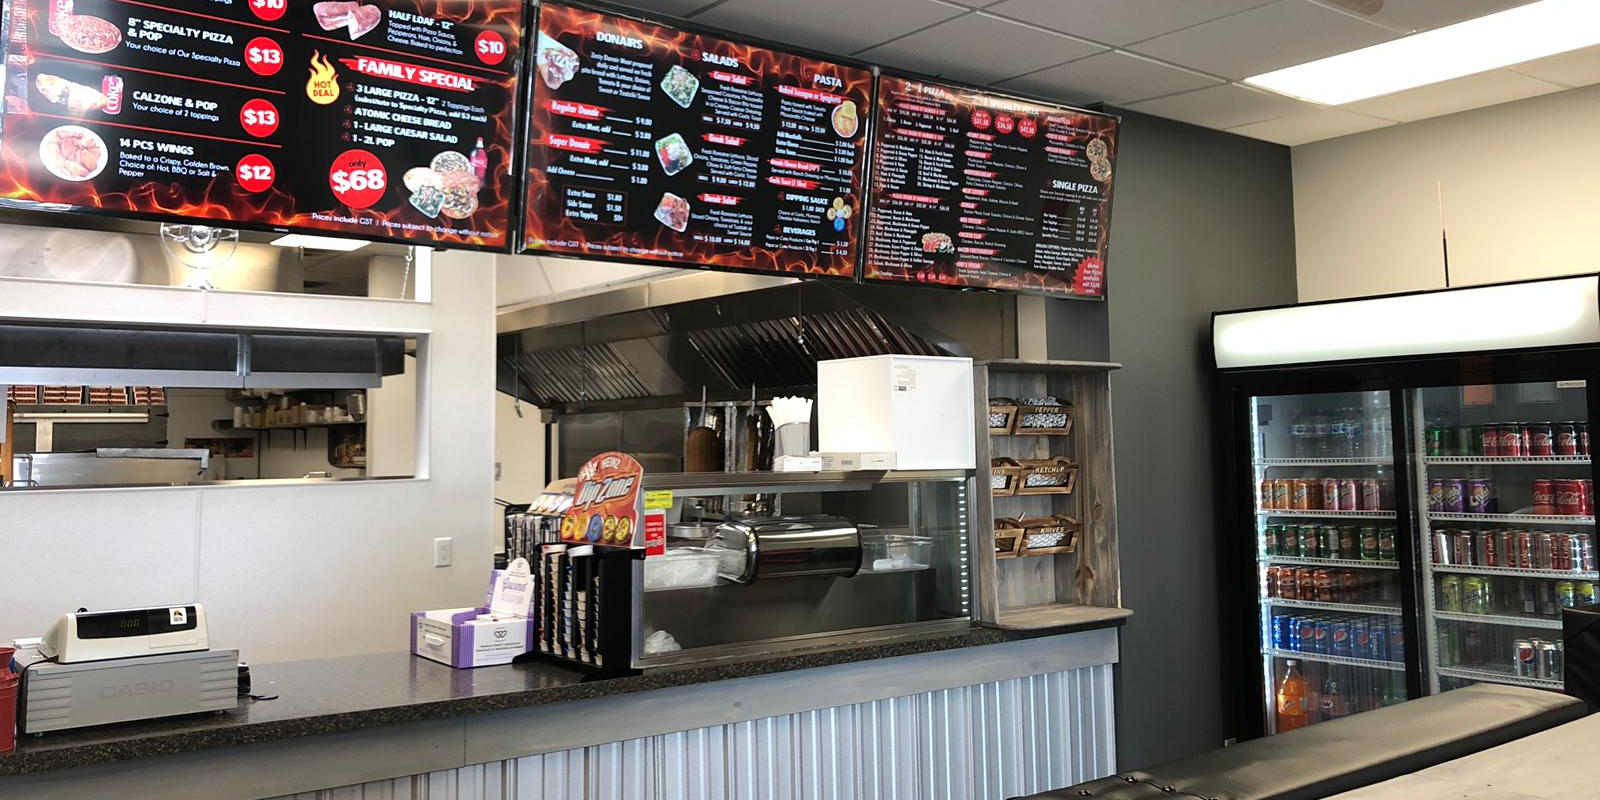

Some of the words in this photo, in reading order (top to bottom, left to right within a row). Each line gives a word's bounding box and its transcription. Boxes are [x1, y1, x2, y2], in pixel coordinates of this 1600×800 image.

[389, 10, 411, 22] HALF
[411, 16, 435, 27] LOAF
[127, 28, 137, 37] &
[139, 31, 163, 41] POP
[143, 20, 201, 38] SPECIALTY
[202, 31, 234, 45] PIZZA
[595, 31, 644, 49] DONAIRS
[125, 41, 142, 50] Your
[143, 44, 167, 54] choice
[168, 48, 177, 56] of
[177, 49, 190, 58] Our
[191, 52, 223, 64] Specialty
[223, 57, 241, 67] Pizza
[478, 39, 504, 54] $10
[249, 48, 280, 64] $13
[702, 52, 739, 68] SALADS
[357, 58, 417, 80] FAMILY
[419, 70, 476, 90] SPECIAL
[814, 73, 843, 88] PASTA
[313, 81, 331, 89] HOT
[313, 89, 334, 97] DEAL
[356, 84, 363, 93] 3
[364, 85, 393, 99] LARGE
[393, 91, 420, 103] PIZZA
[133, 90, 183, 107] CALZONE
[184, 98, 194, 108] &
[195, 100, 218, 112] POP
[133, 102, 149, 110] Your
[149, 105, 174, 116] choice
[175, 109, 183, 117] of
[184, 110, 189, 118] 2
[190, 111, 220, 122] toppings
[244, 108, 276, 125] $13
[354, 107, 391, 121] ATOMIC
[391, 113, 422, 126] CHEESE
[423, 118, 453, 130] BREAD
[399, 102, 429, 115] Specialty
[449, 111, 461, 119] add
[352, 134, 357, 142] 1
[364, 135, 375, 145] 2L
[376, 138, 396, 148] POP
[353, 121, 358, 130] 1
[364, 122, 393, 134] LARGE
[393, 127, 429, 139] CAESAR
[429, 133, 459, 144] SALAD
[119, 138, 132, 148] 14
[132, 139, 155, 151] PCS
[156, 142, 194, 156] WINGS
[549, 135, 568, 148] Super
[120, 151, 143, 162] Baked
[144, 154, 152, 162] to
[183, 160, 209, 170] Golden
[120, 160, 146, 170] Choice
[171, 166, 188, 175] BBQ
[197, 169, 211, 177] Salt
[348, 159, 368, 169] only
[119, 168, 145, 178] Pepper
[239, 164, 272, 181] $12
[331, 169, 385, 194] $68
[1053, 179, 1077, 192] SINGLE
[1077, 183, 1099, 194] PIZZA
[312, 212, 333, 222] Prices
[358, 217, 373, 226] GST
[783, 226, 817, 236] BEVERAGES
[1035, 466, 1065, 474] KETCHUP
[1040, 526, 1065, 534] KNIVES
